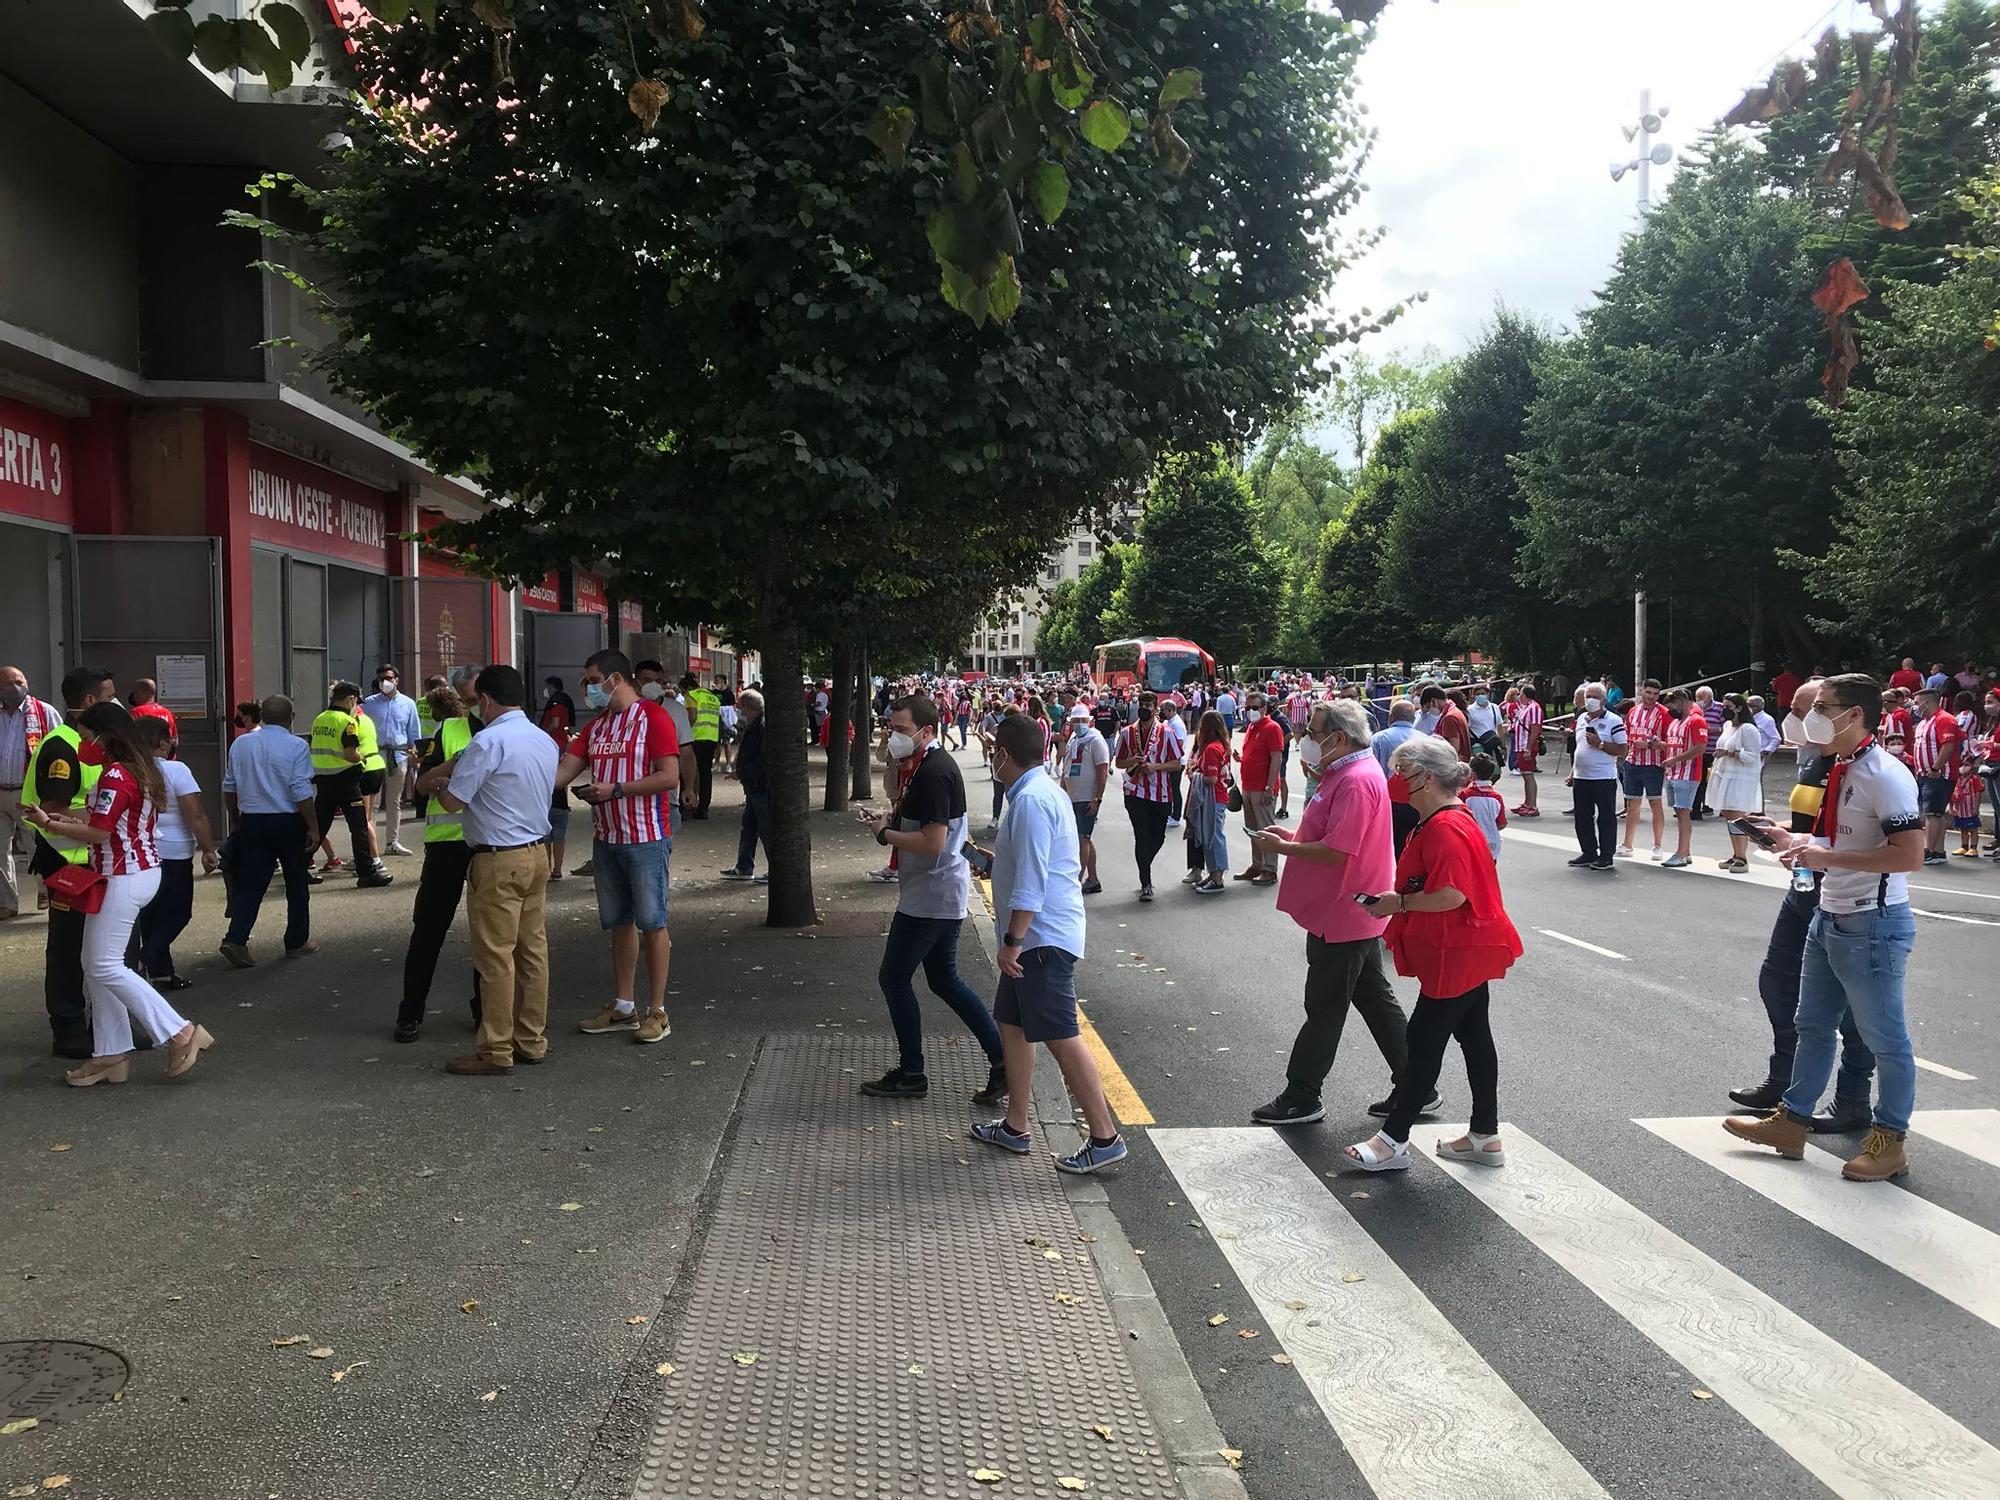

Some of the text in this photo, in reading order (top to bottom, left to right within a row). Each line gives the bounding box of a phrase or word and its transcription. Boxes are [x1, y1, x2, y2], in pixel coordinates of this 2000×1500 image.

[50, 442, 62, 496] 3
[296, 483, 333, 535] OESTE
[340, 498, 379, 548] PUERTA
